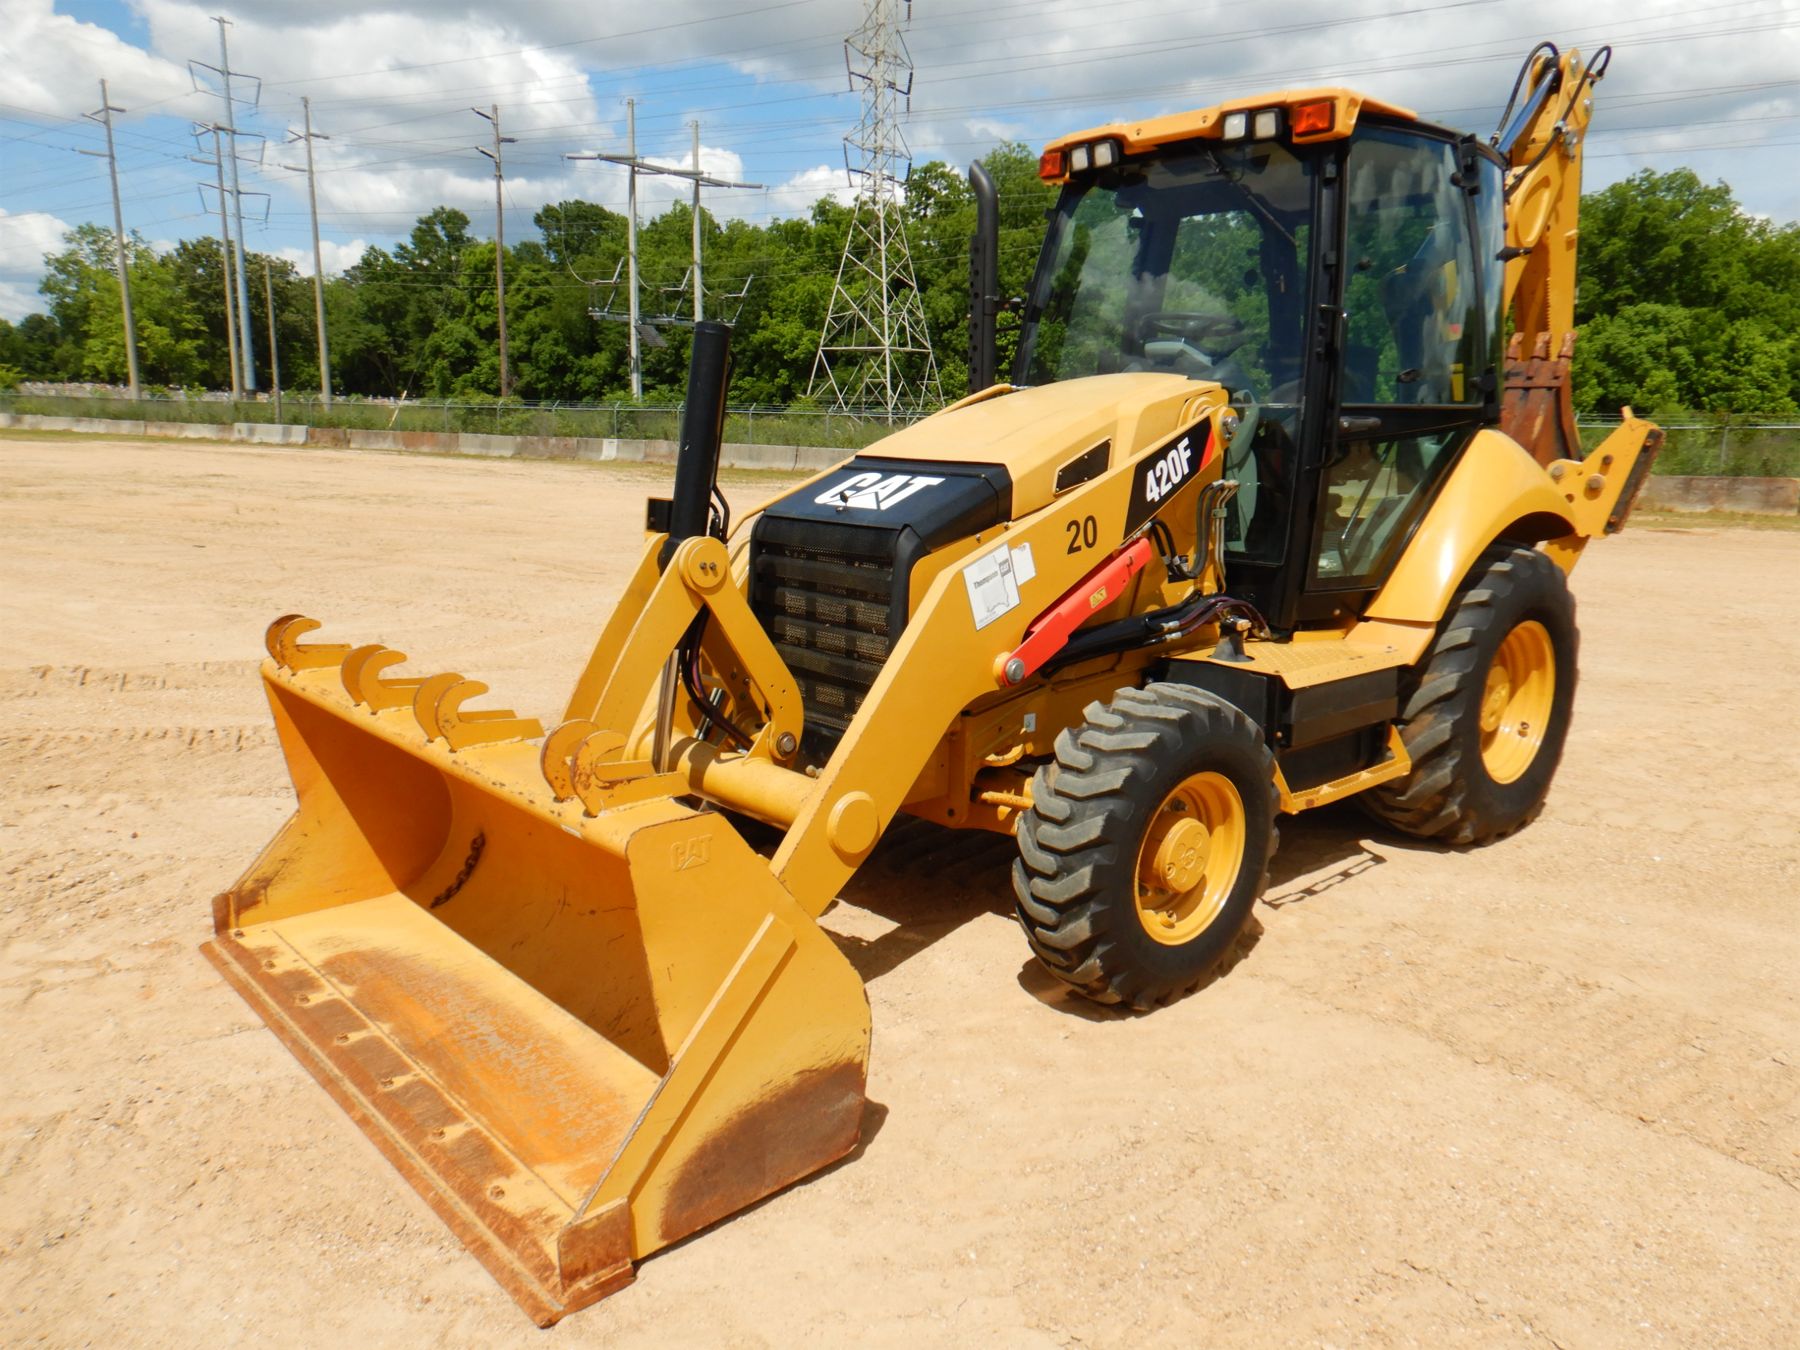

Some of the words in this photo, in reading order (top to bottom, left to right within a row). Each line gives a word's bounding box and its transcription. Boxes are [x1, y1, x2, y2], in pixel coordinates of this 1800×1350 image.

[1146, 437, 1191, 502] 420F
[814, 472, 946, 511] CAT
[1066, 515, 1098, 555] 20
[670, 834, 713, 873] CAT
